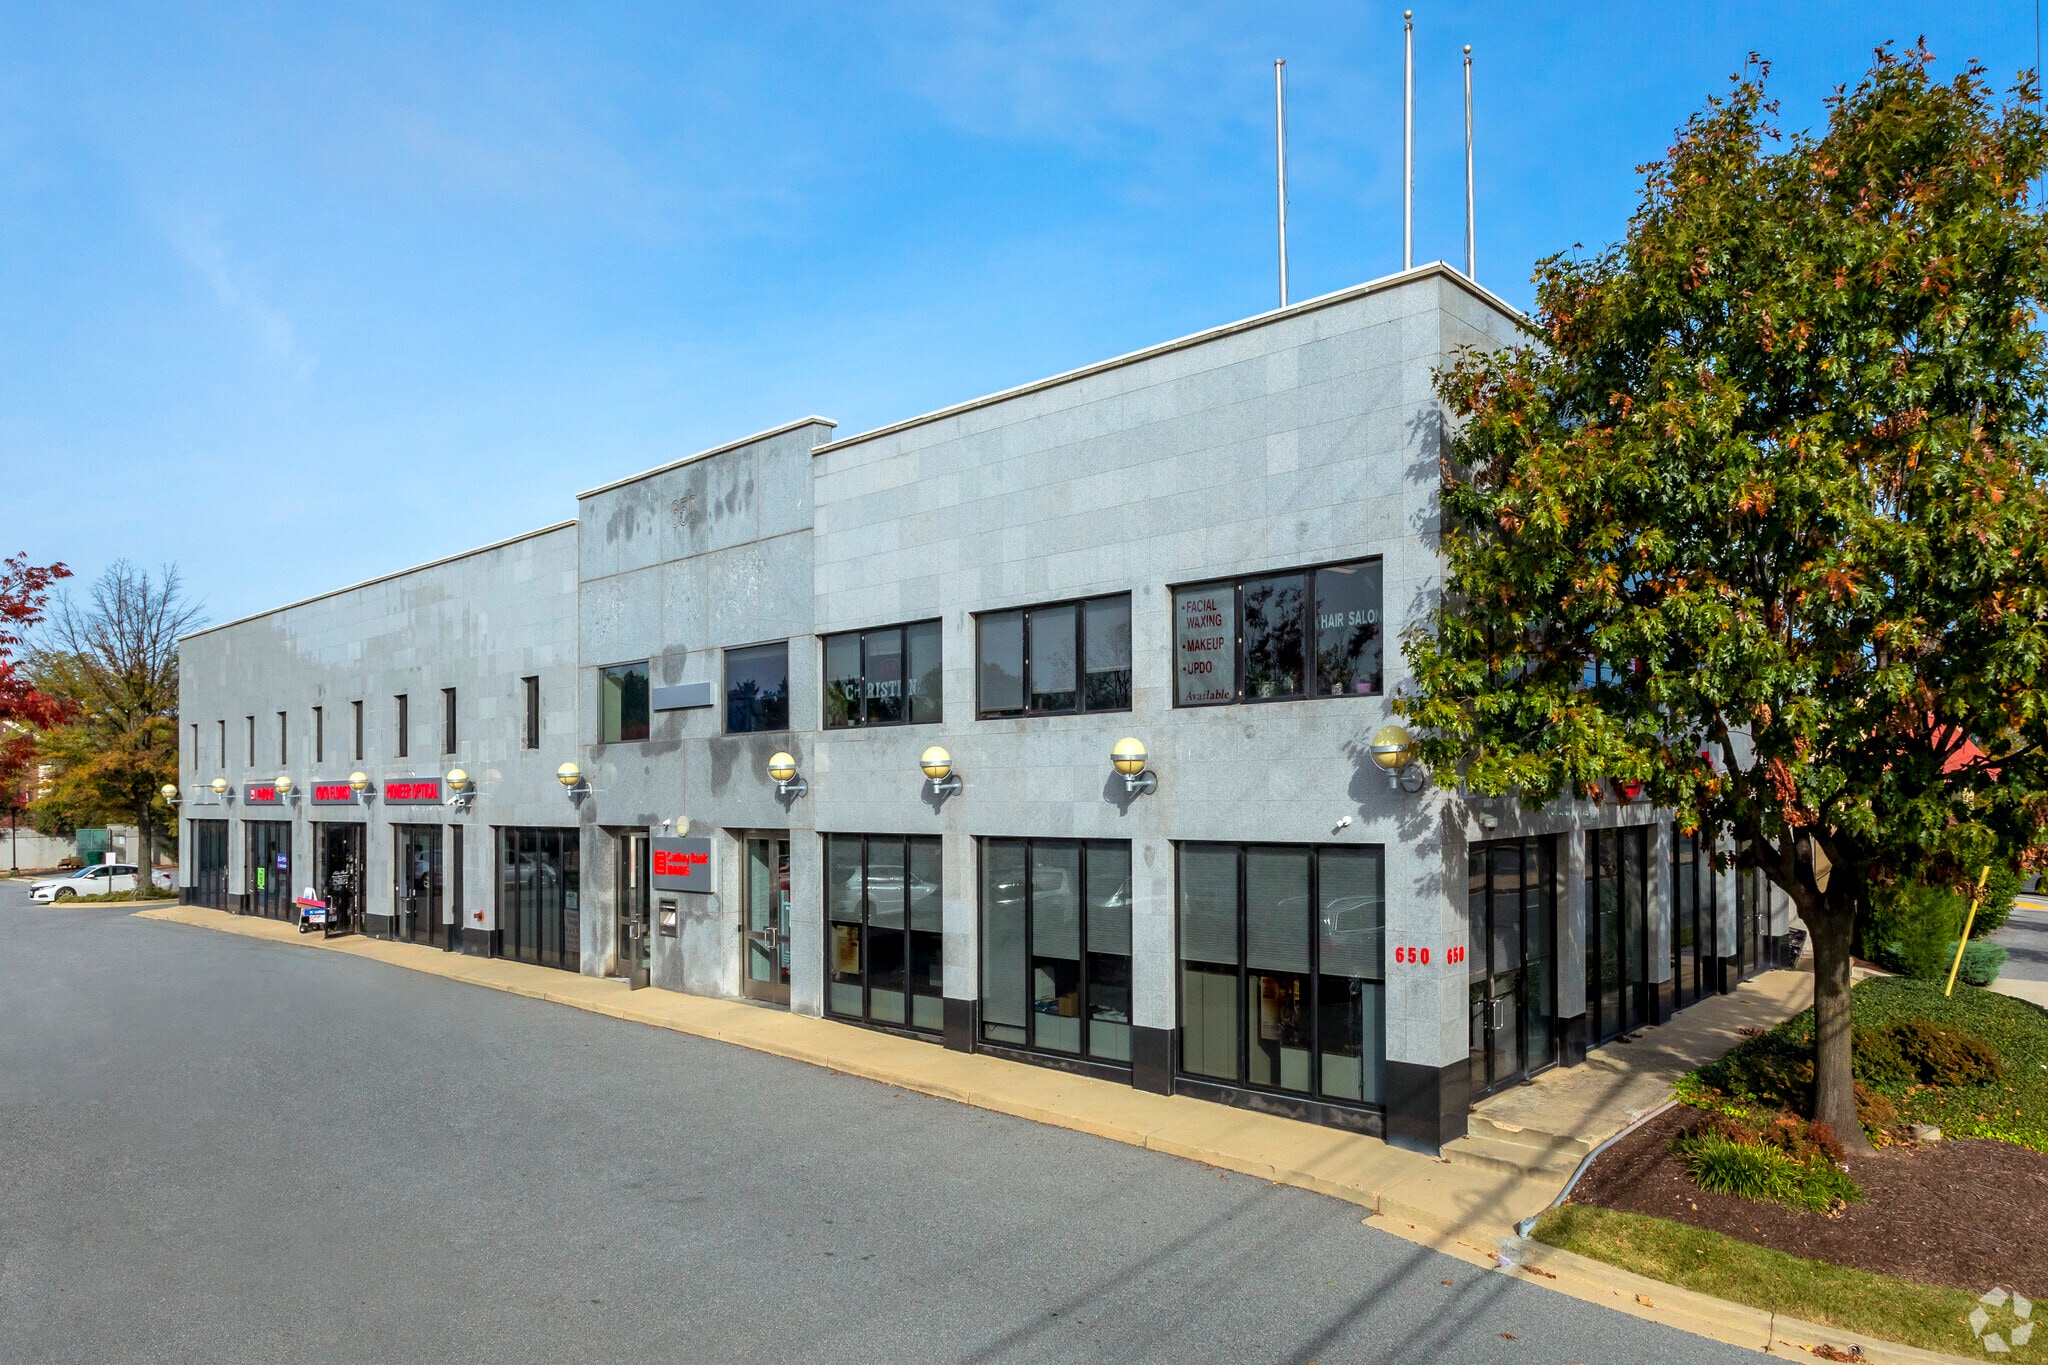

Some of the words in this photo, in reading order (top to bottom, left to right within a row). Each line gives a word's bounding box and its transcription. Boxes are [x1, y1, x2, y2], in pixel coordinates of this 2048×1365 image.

[1186, 599, 1217, 613] FACIAL
[1186, 613, 1222, 629] WAXING
[1320, 612, 1344, 629] HAIR
[1348, 608, 1382, 626] SALON
[1187, 636, 1225, 652] MAKEUP
[1187, 660, 1213, 675] UPDO
[845, 678, 918, 700] CHRISTIN
[1185, 688, 1230, 701] Available
[385, 783, 412, 799] PIONEER
[413, 782, 439, 799] OPTICAL
[1395, 946, 1430, 965] 650
[1447, 946, 1465, 965] 650
